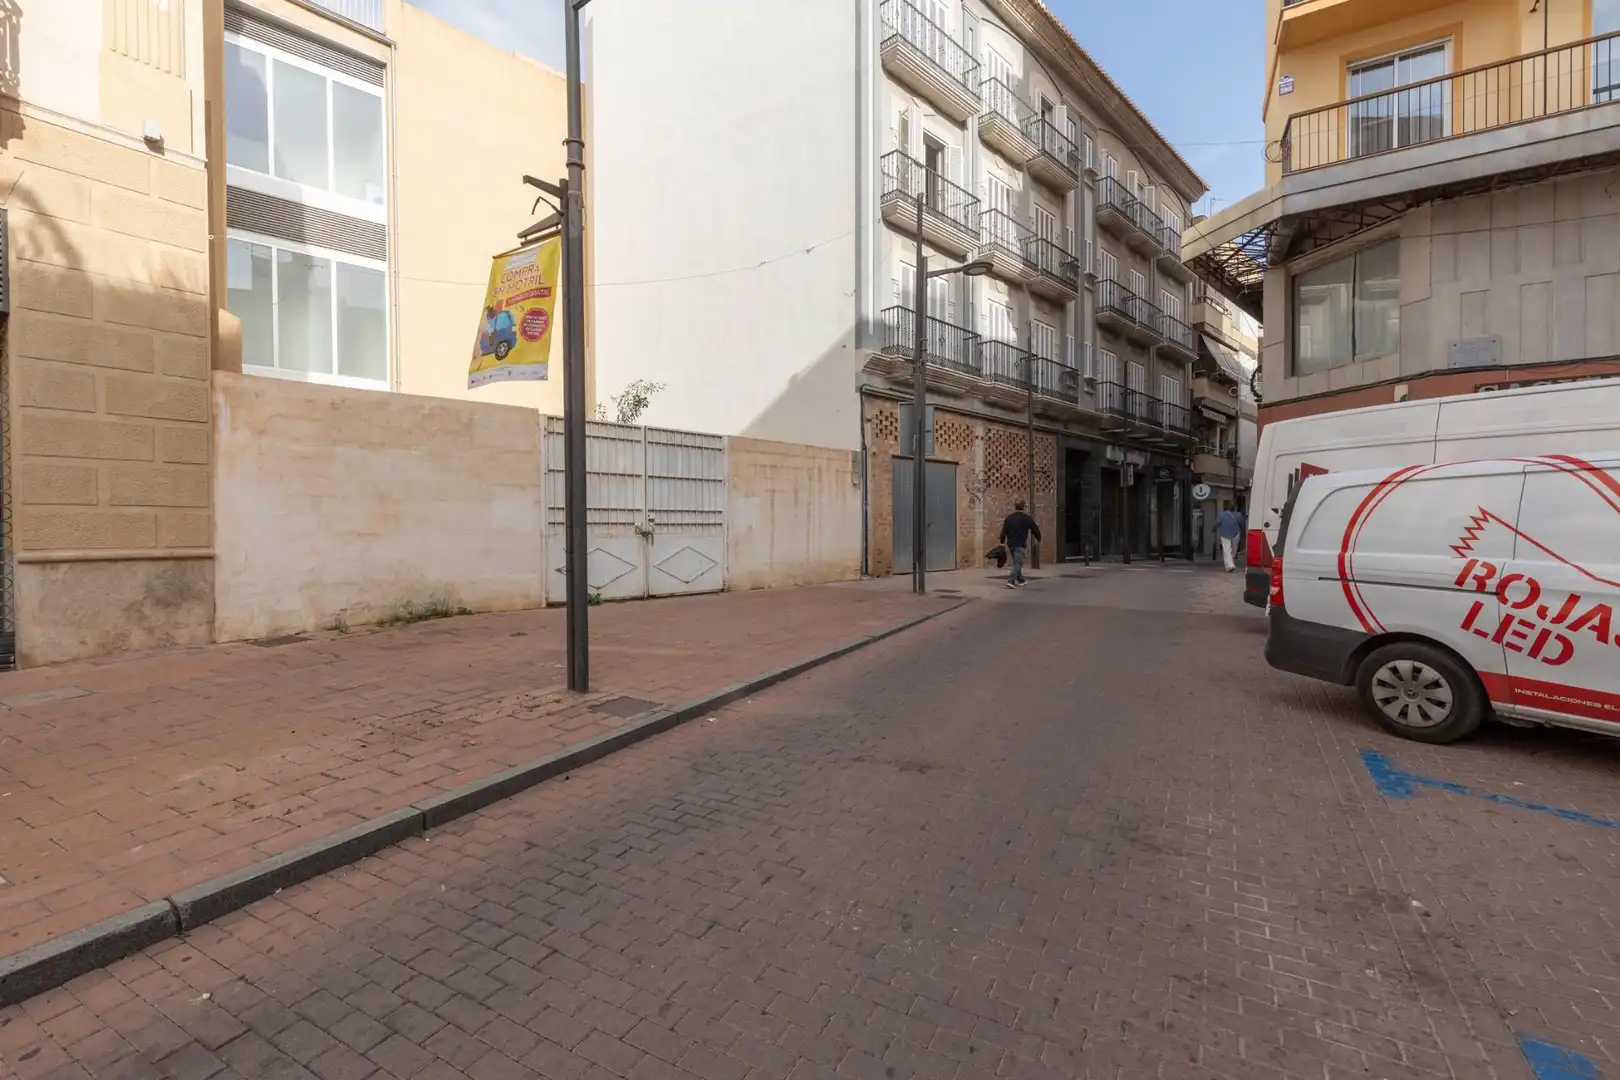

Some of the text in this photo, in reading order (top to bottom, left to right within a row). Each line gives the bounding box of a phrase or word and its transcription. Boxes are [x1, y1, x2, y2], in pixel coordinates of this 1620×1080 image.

[493, 285, 504, 297] EN
[506, 273, 544, 294] MOTRIL
[501, 264, 539, 284] COMPRA
[1454, 558, 1620, 648] ROJA
[1460, 600, 1574, 666] LED
[1514, 688, 1620, 712] INSTALACIONES EL
